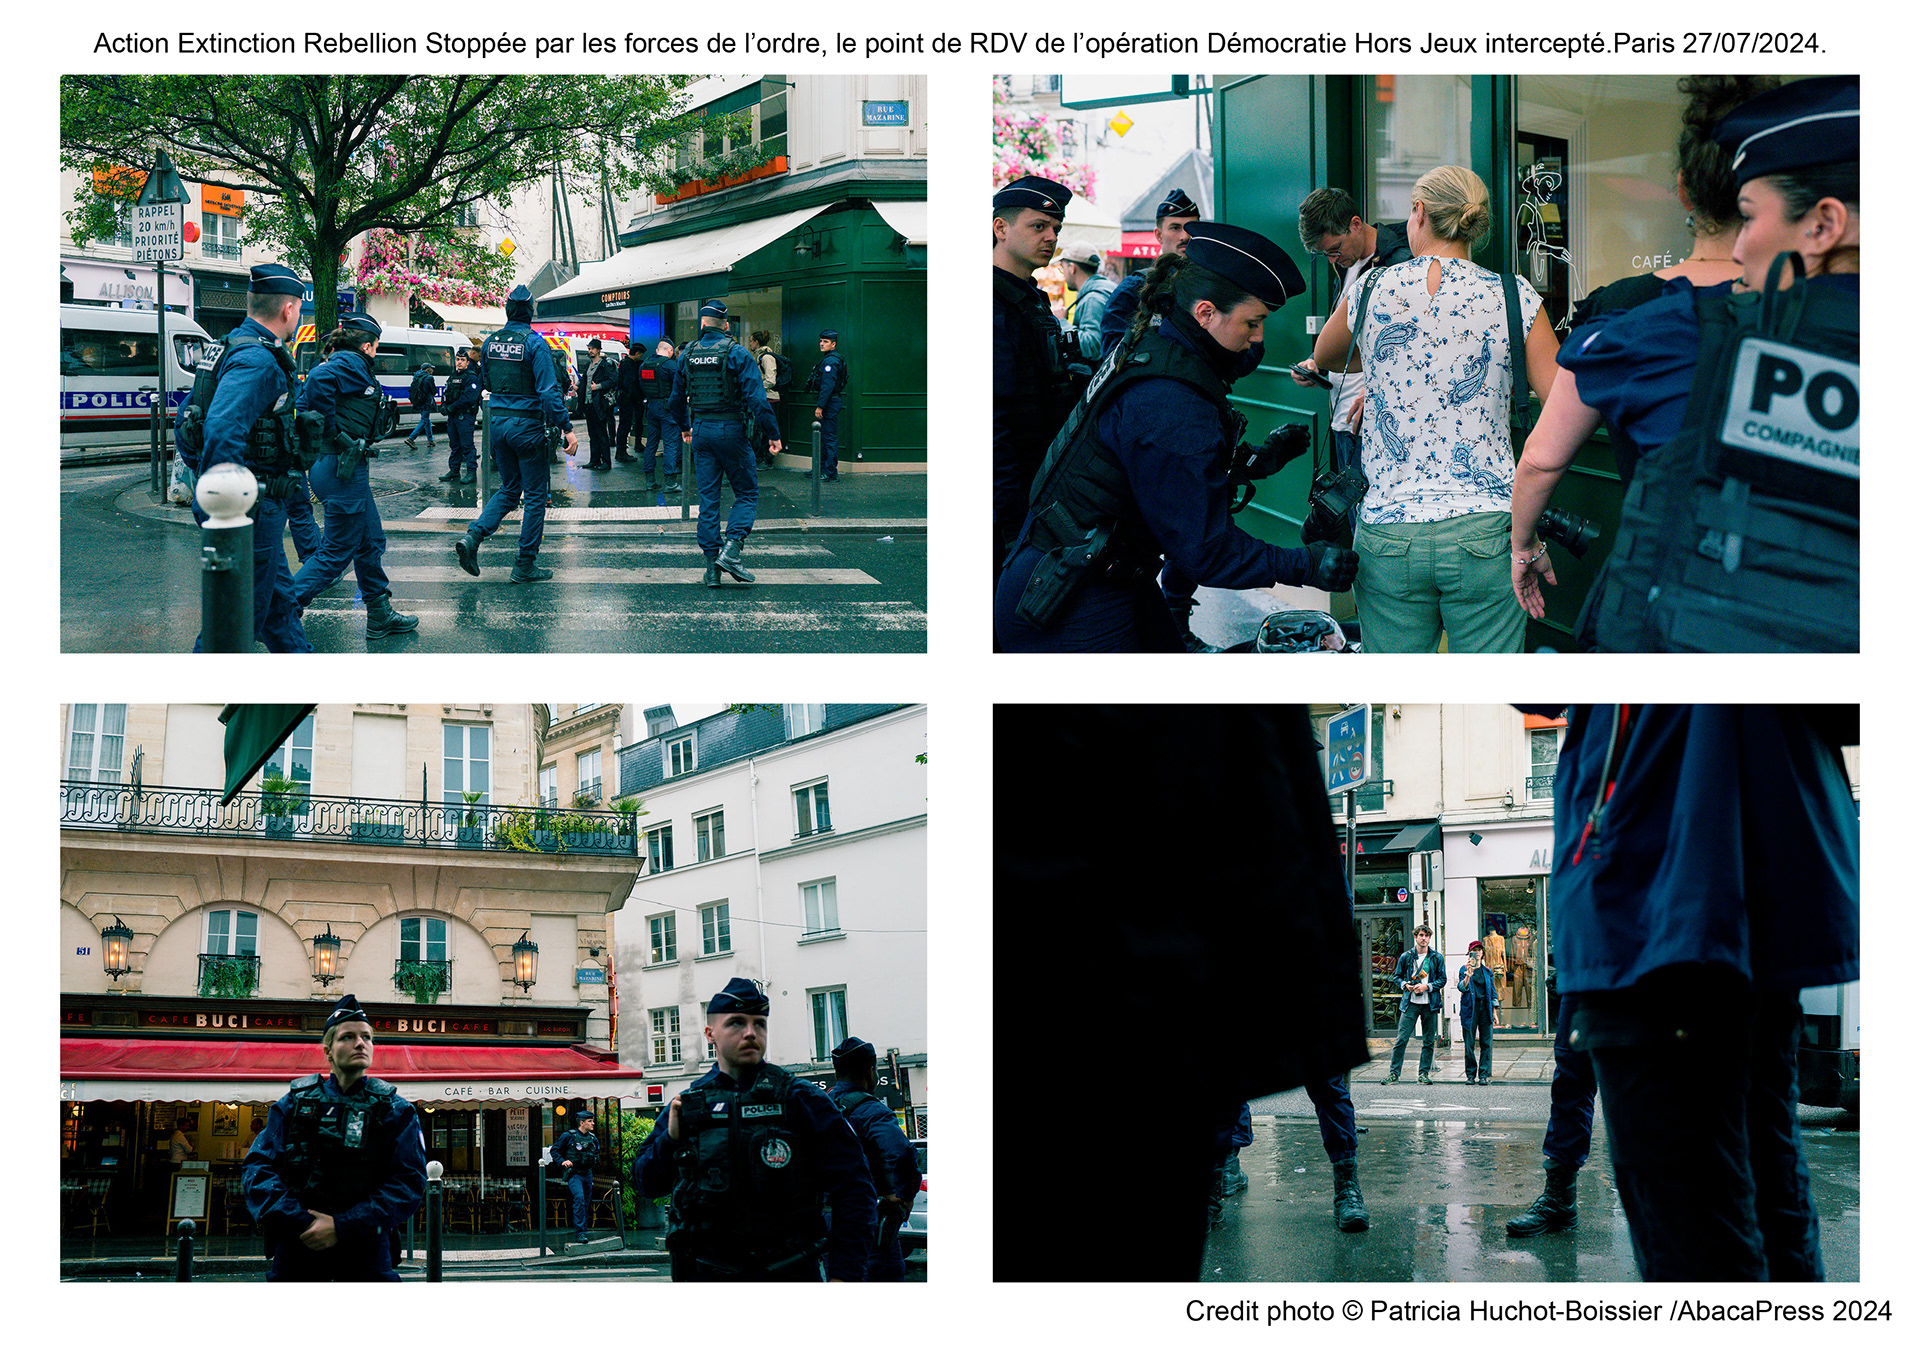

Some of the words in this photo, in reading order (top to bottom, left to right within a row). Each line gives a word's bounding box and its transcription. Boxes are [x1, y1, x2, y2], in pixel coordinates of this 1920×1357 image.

[138, 204, 175, 218] RAPPEL
[138, 221, 151, 233] 20
[154, 219, 175, 232] km/h
[135, 231, 179, 247] PRIORITÉ
[136, 247, 177, 260] PIÉTONS
[1133, 246, 1162, 256] ATL
[1631, 250, 1673, 269] CAFÉ
[99, 282, 154, 300] ALLISON
[601, 290, 630, 303] COMPTOIRS
[490, 343, 522, 354] POLICE
[689, 356, 718, 366] POLICE
[72, 393, 159, 407] POLIC
[148, 1015, 189, 1024] CAFE
[196, 1013, 248, 1028] BUCI
[254, 1018, 294, 1027] CAFE
[376, 1021, 391, 1029] FE
[397, 1018, 446, 1033] BUCI
[452, 1022, 489, 1031] CAFE
[444, 1085, 473, 1096] CAFÉ
[488, 1087, 510, 1095] BAR
[525, 1085, 569, 1095] CUISINE
[744, 1105, 780, 1114] POLICE
